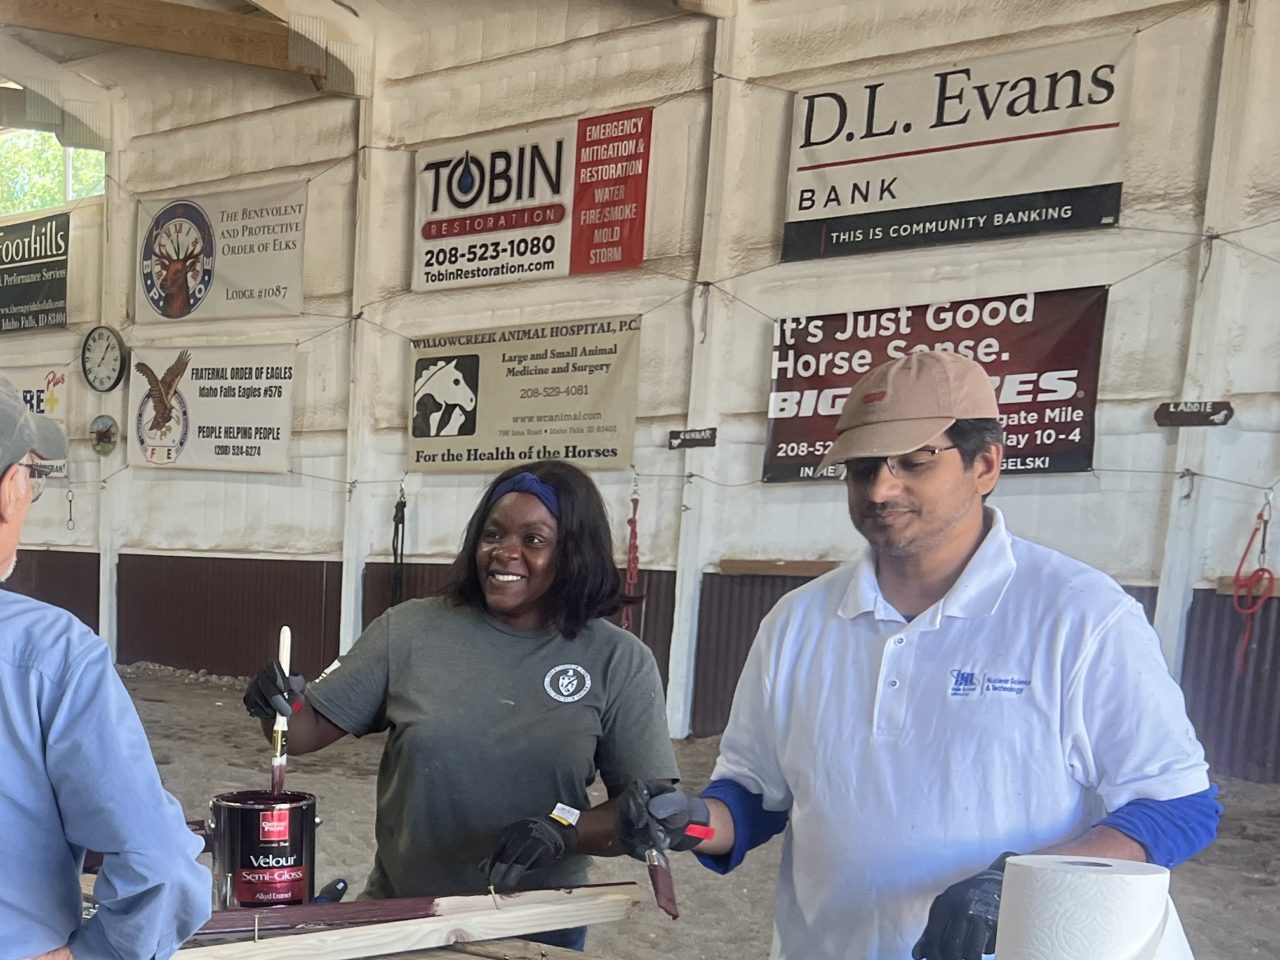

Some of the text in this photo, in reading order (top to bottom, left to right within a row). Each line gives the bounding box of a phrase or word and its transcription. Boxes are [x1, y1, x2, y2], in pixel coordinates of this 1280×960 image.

[799, 63, 1116, 150] D.L. Evans
[586, 117, 644, 142] EMERGENCY
[581, 139, 645, 163] MITIGATION &
[423, 138, 564, 212] TOBIN
[580, 159, 643, 184] RESTORATION
[594, 185, 625, 204] WATER
[798, 177, 898, 211] BANK
[430, 208, 556, 236] RESTORATION
[580, 203, 637, 226] FIRE/SMOKE
[831, 205, 1073, 245] THIS IS COMMUNITY BANKING
[593, 227, 621, 244] MOLD
[424, 235, 556, 267] 208-523-1080
[589, 247, 622, 265] STORM
[4, 271, 41, 287] Performance
[42, 267, 67, 281] Services
[424, 258, 555, 284] TobinRestoration.com
[2, 317, 20, 331] Idaho
[21, 315, 38, 328] Falls,
[38, 314, 47, 327] ID
[834, 306, 912, 342] Just
[925, 292, 1036, 332] Good
[412, 319, 641, 349] WILLOWCREEK ANIMAL HOSPITAL, P.C.
[502, 344, 618, 366] Large and Small Animal
[771, 348, 872, 380] Horse
[191, 366, 293, 380] FRATERNAL ORDER OF EAGLES
[505, 362, 612, 378] Medicine and Surgery
[44, 370, 65, 392] Plus
[198, 385, 282, 399] Idaho Falls Eagles #576
[520, 385, 589, 400] 208-529-4081
[768, 387, 852, 419] BIG
[1169, 402, 1213, 413] LADDIE
[512, 411, 602, 424] www.wcanimal.com
[1043, 405, 1084, 423] Mile
[197, 426, 281, 440] PEOPLE HELPING PEOPLE
[214, 445, 261, 456] (208) 524-6274
[415, 445, 618, 463] For the Health of the Horses
[991, 685, 1024, 695] Technology
[250, 854, 295, 867] Velour
[242, 870, 303, 882] Semi-Gloss
[272, 891, 292, 900] Enamel
